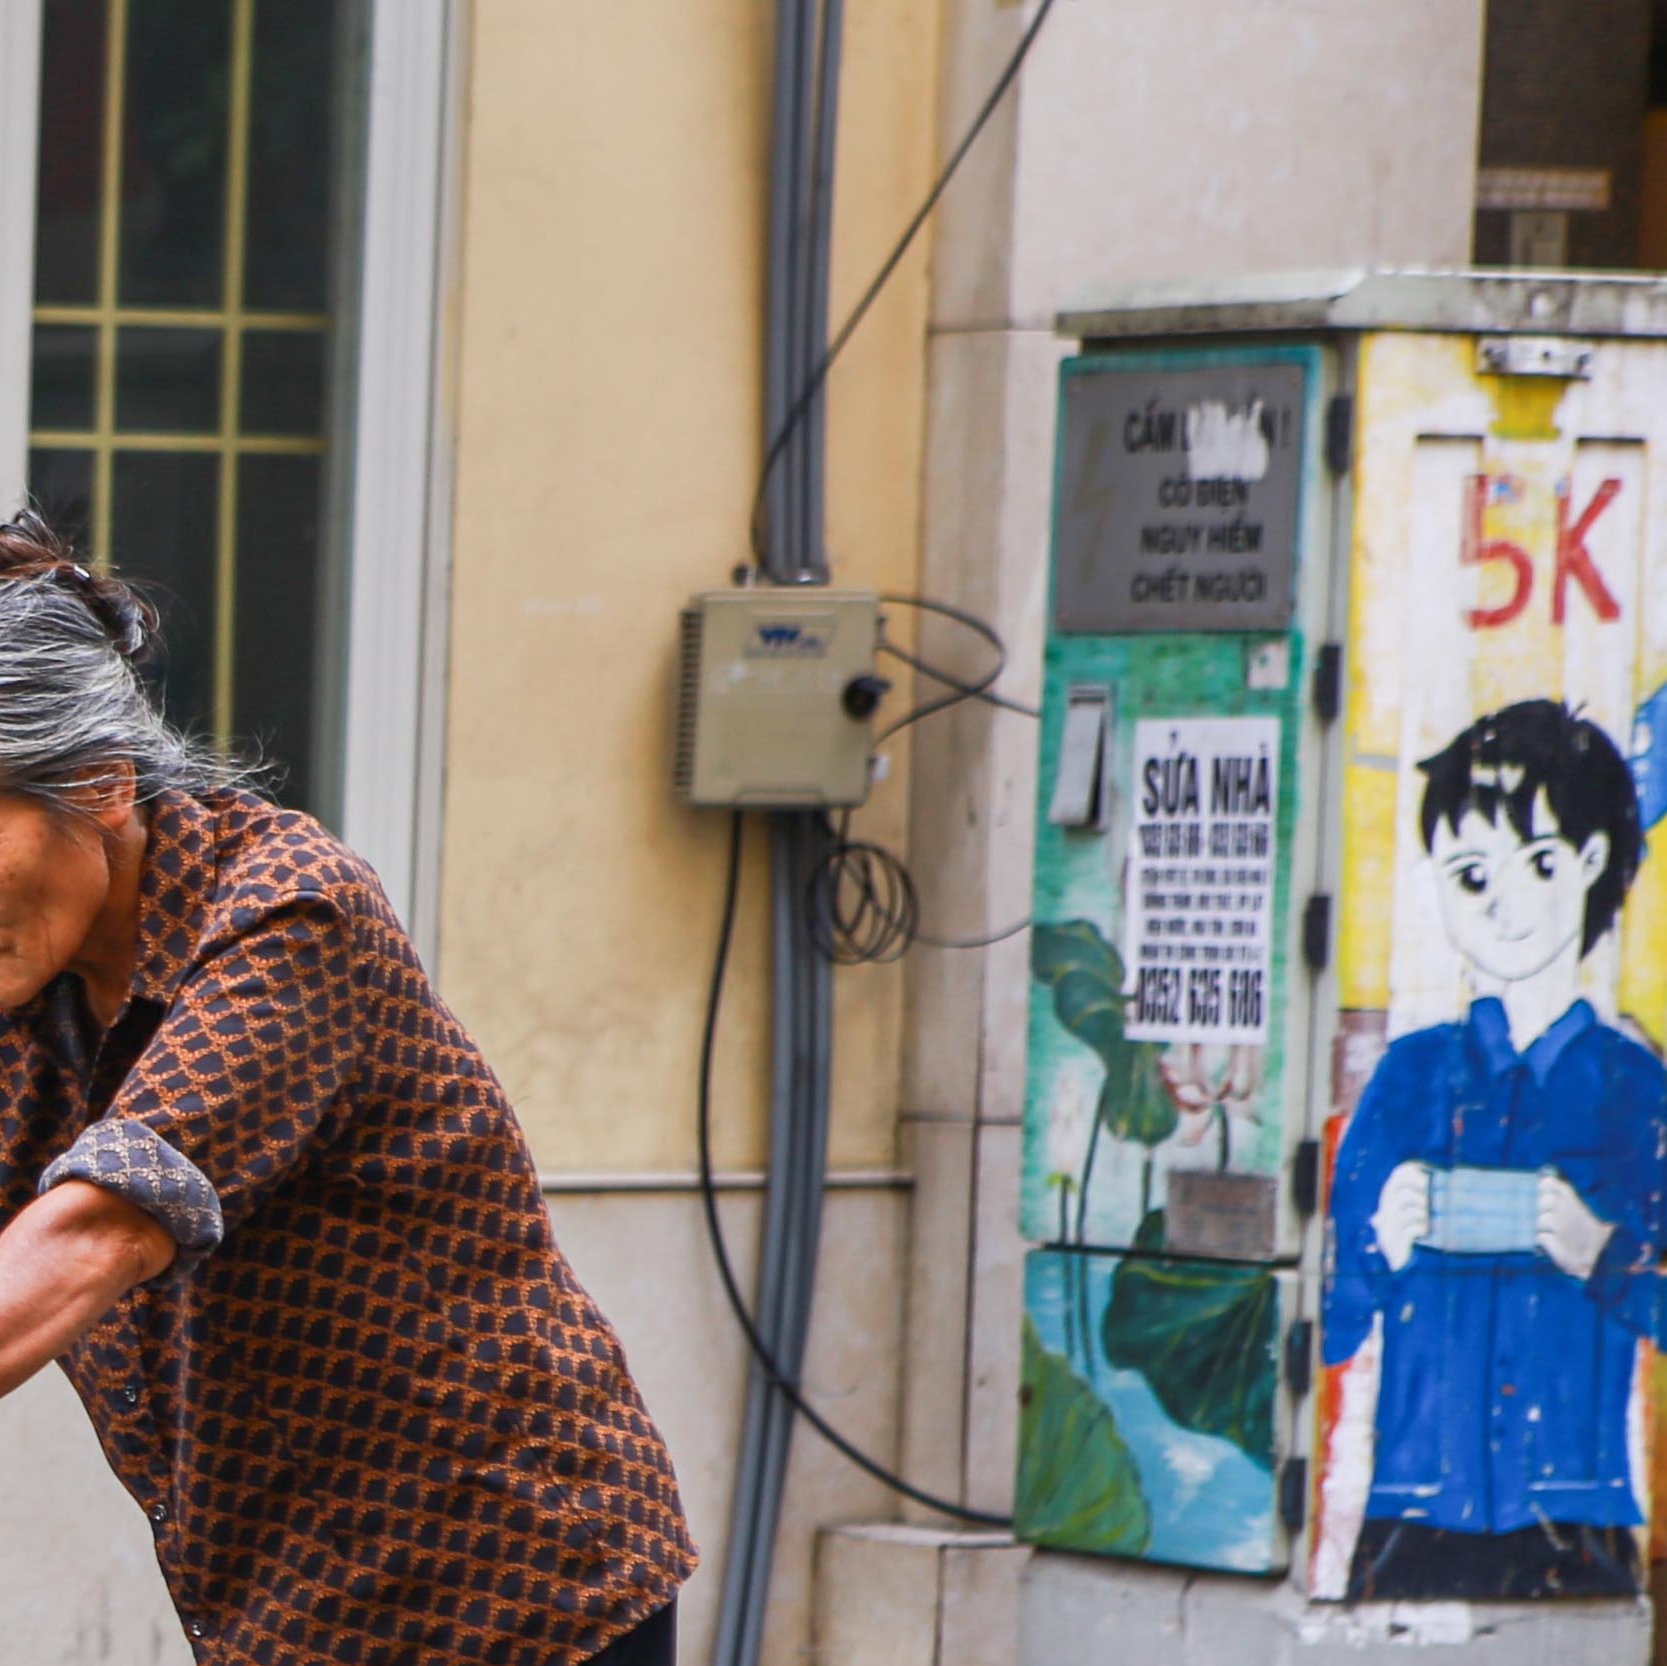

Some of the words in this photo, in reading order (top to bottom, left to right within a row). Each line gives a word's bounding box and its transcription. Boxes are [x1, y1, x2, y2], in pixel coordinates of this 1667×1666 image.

[1140, 524, 1202, 554] NGUY
[1461, 473, 1622, 630] 5K
[1142, 730, 1200, 816] SỬA
